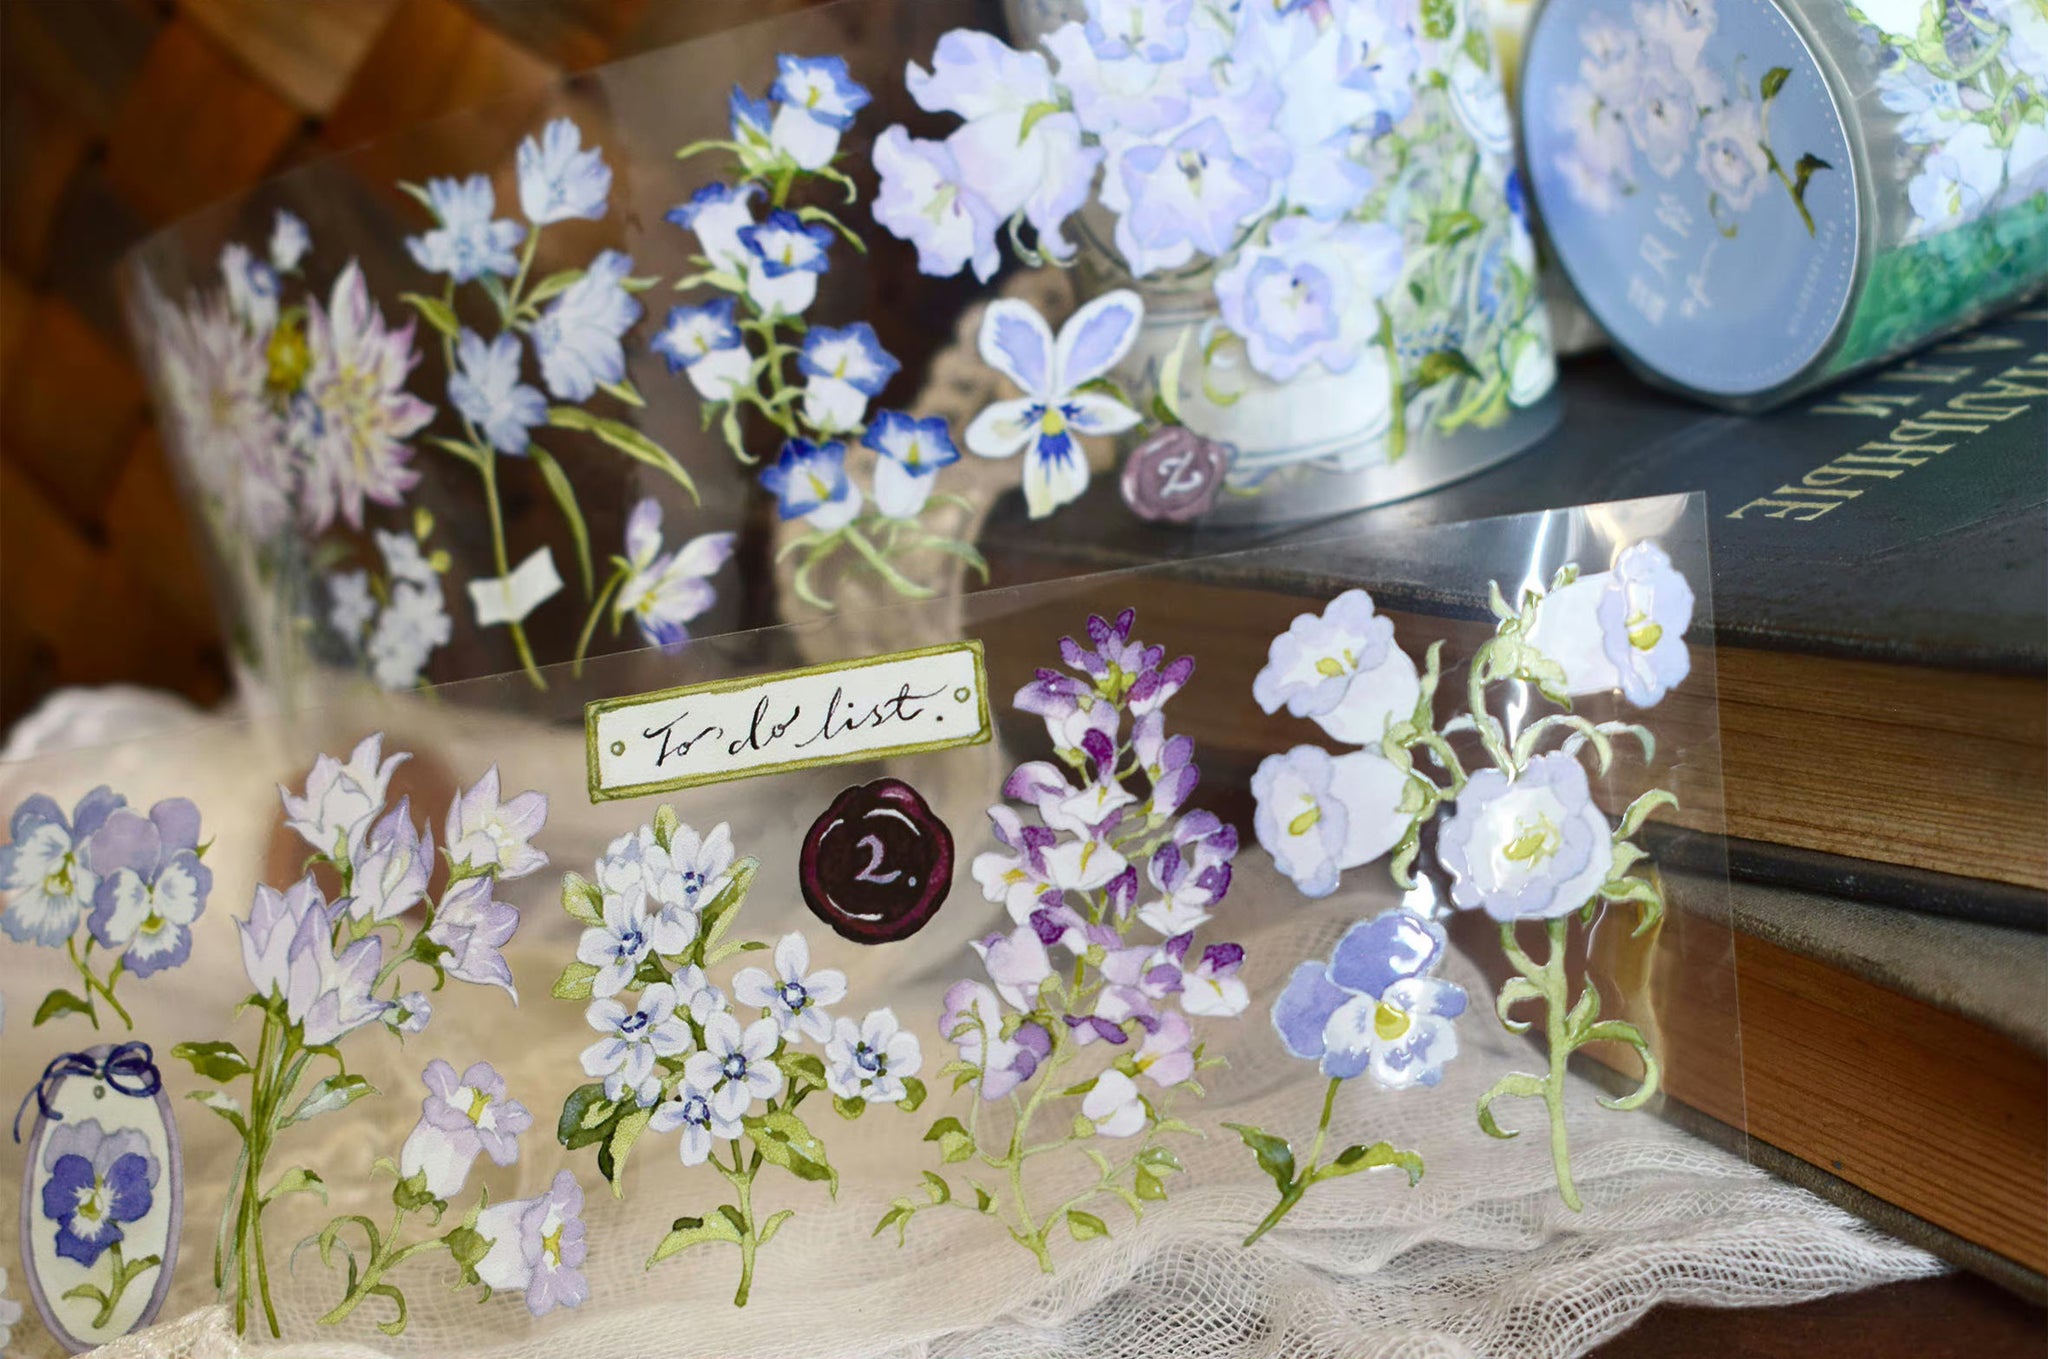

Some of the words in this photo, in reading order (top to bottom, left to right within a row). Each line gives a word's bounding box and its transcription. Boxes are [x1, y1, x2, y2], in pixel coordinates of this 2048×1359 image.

[643, 711, 724, 767] To
[728, 694, 801, 755] do
[854, 834, 918, 887] 2.
